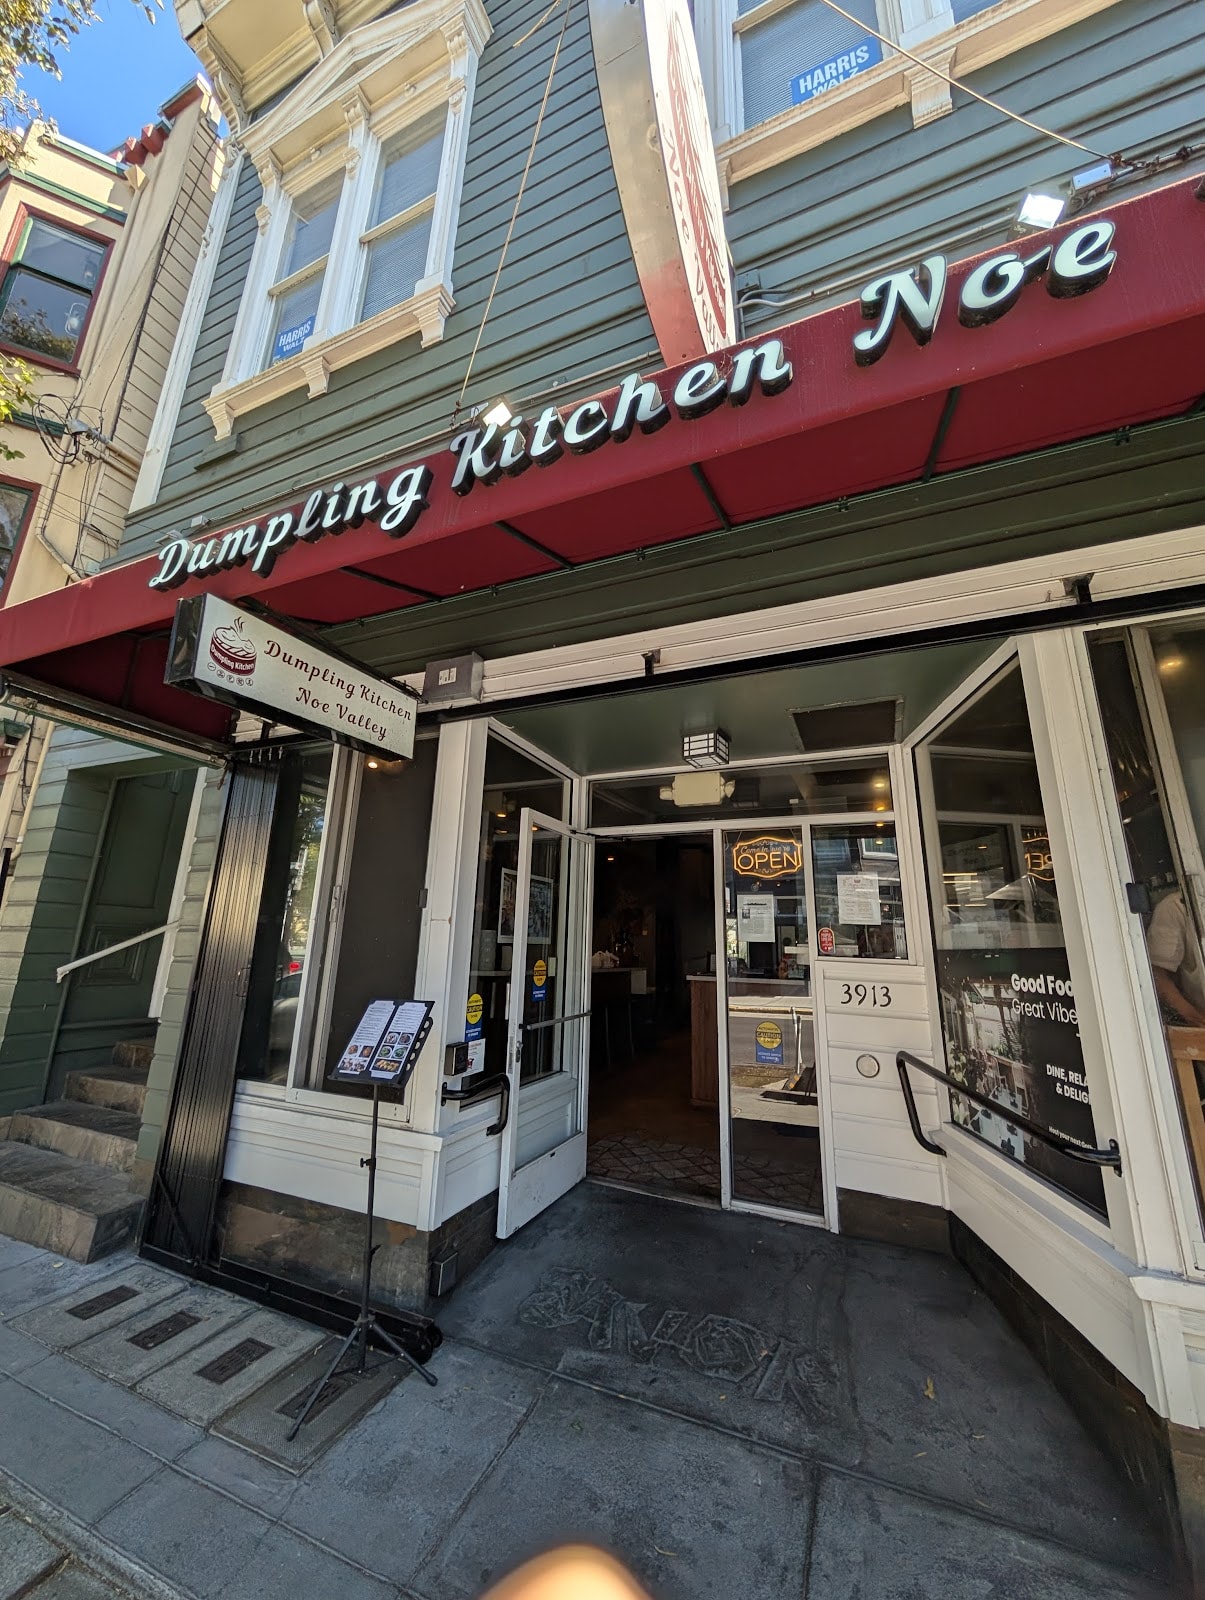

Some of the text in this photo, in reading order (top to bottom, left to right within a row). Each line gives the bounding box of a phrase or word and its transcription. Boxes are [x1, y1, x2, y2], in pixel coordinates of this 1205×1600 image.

[799, 45, 869, 94] HARRIS
[694, 245, 722, 351] Vall
[278, 320, 311, 347] HARRIS
[149, 221, 1117, 590] Dumpling Kitchen Noe
[210, 643, 255, 671] Dumpling Kitchen
[263, 640, 412, 721] Dumpling Kitchen
[295, 687, 387, 742] Noe Valley
[737, 850, 798, 871] OPEN
[840, 983, 892, 1008] 3913
[1010, 973, 1075, 998] Good Foo
[1011, 998, 1079, 1025] Great Vibe
[757, 1031, 781, 1039] CAUTION
[1046, 1064, 1068, 1083] DINE,
[1056, 1082, 1091, 1105] & DELIG
